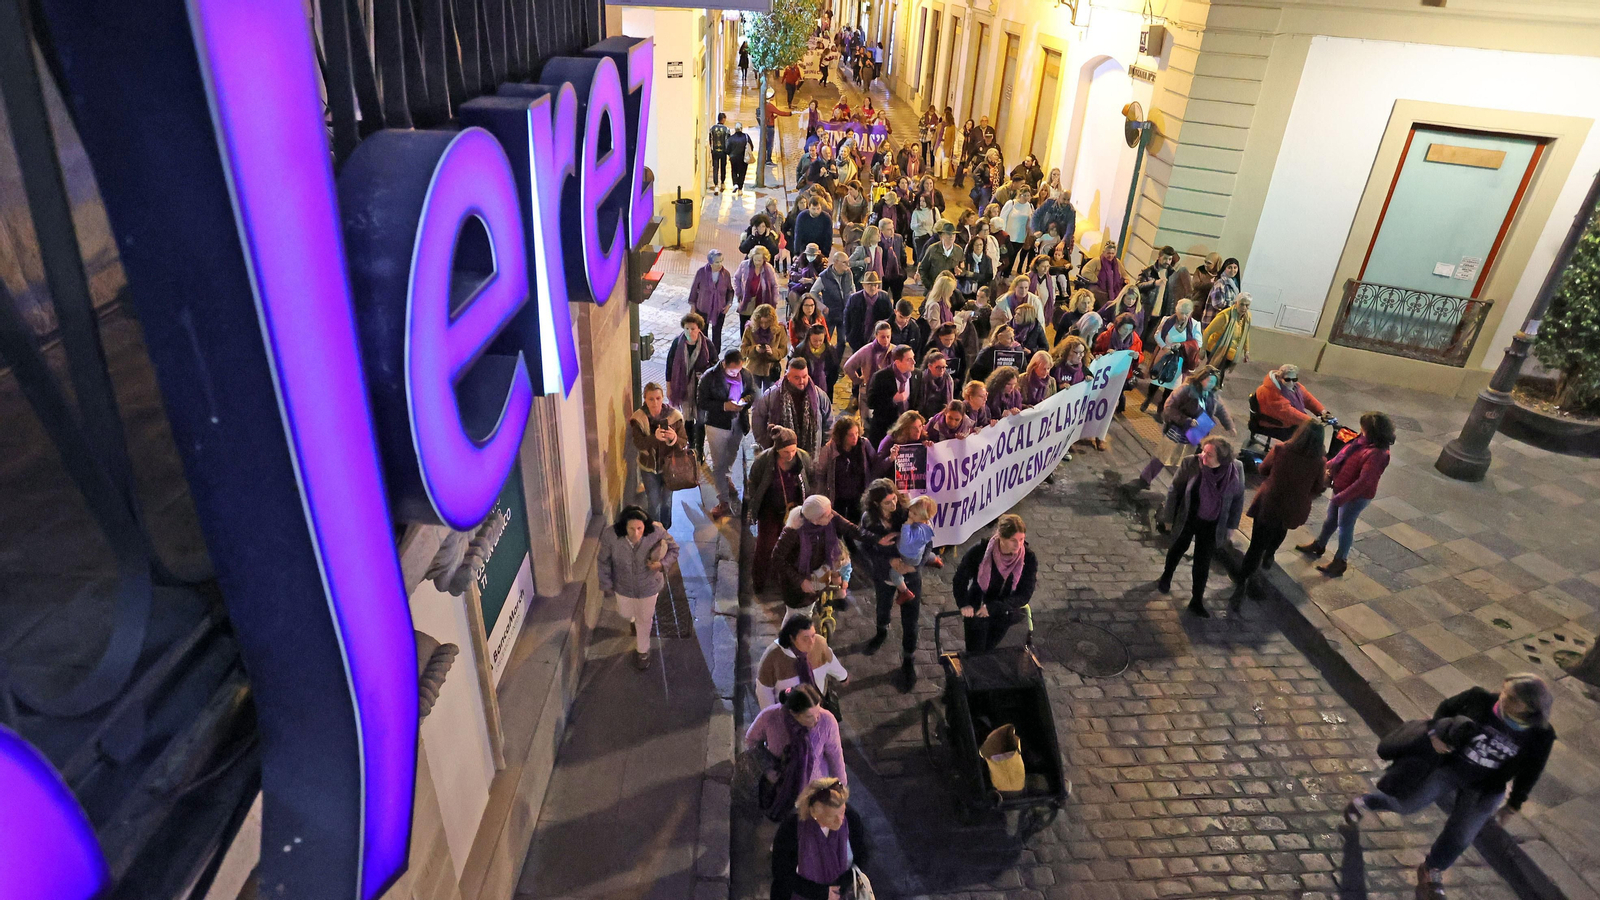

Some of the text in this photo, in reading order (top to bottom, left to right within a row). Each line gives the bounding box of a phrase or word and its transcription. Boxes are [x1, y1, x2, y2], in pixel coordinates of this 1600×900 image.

[0, 0, 655, 900] Jerez
[928, 444, 991, 493] ONSEJO
[990, 421, 1033, 465] LOCAL
[933, 491, 977, 528] NTRA
[979, 478, 992, 511] LA
[492, 588, 525, 663] BancaMarch
